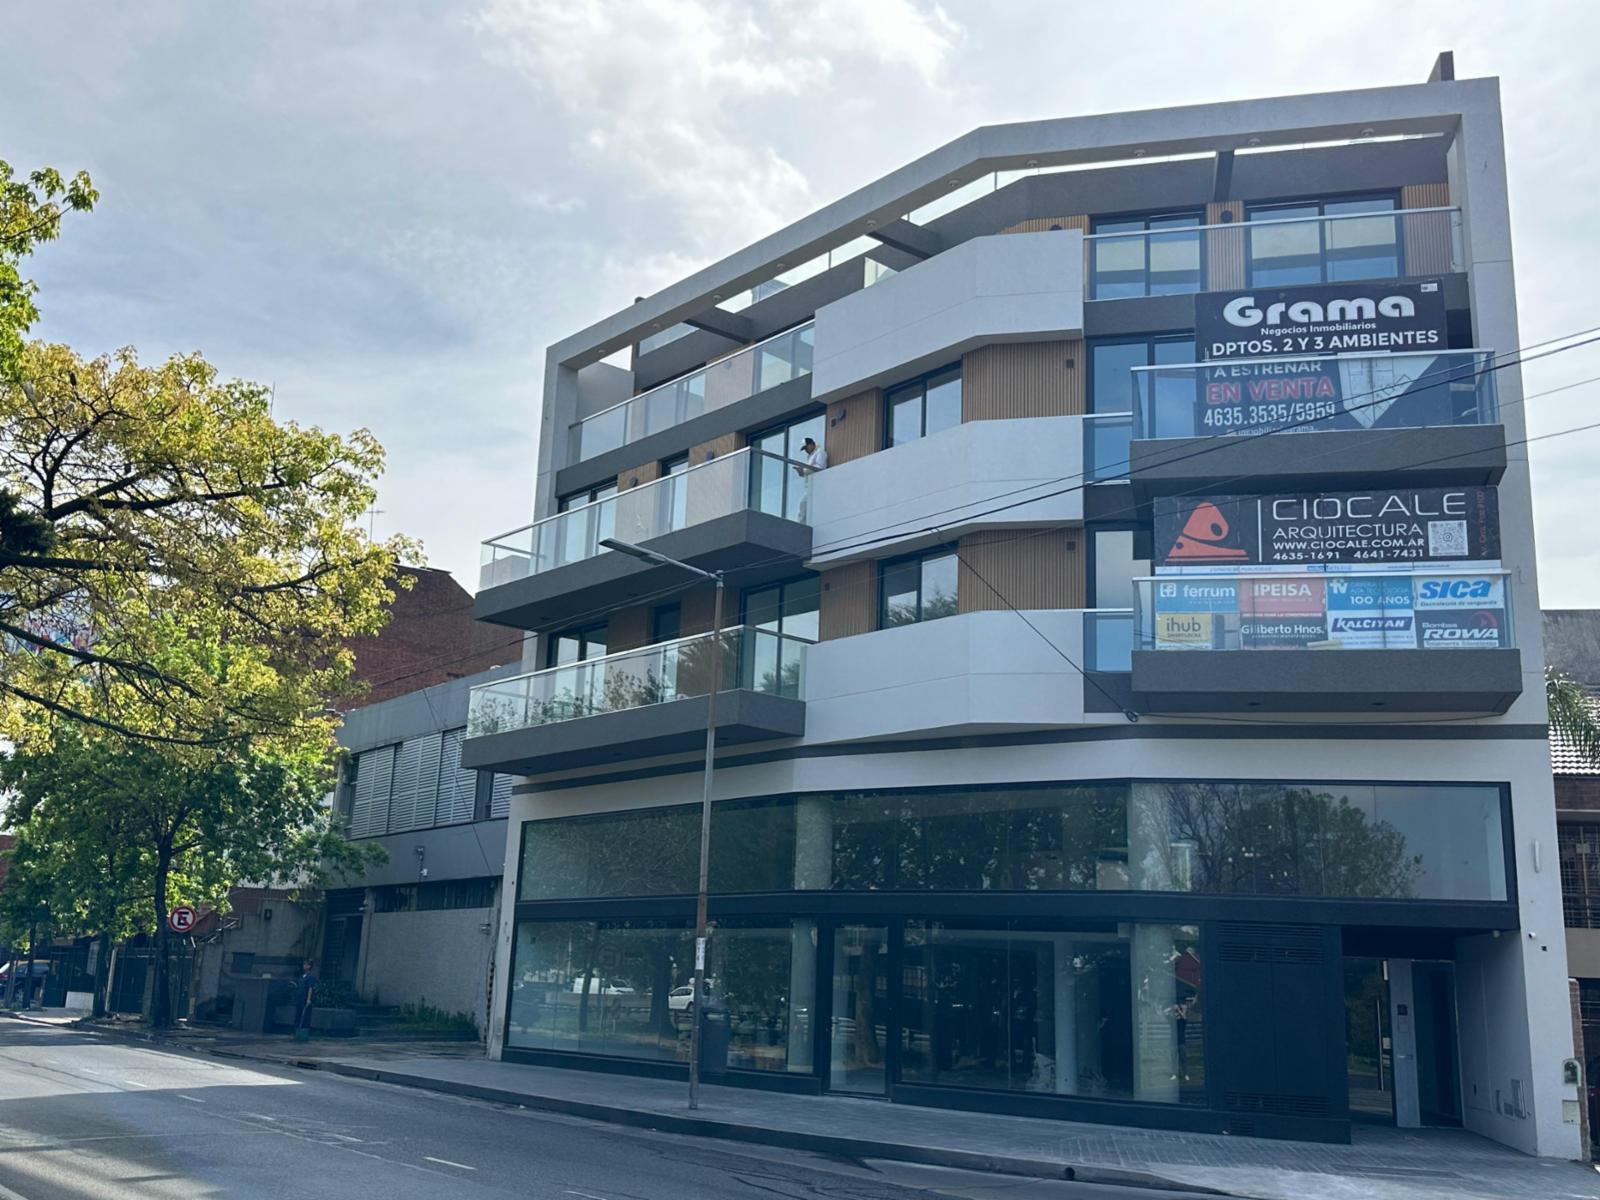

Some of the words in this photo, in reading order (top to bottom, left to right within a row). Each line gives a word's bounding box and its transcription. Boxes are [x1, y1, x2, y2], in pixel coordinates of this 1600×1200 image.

[1223, 295, 1415, 327] Grama
[1261, 326, 1308, 337] Negocios
[1310, 321, 1377, 334] Inmobiliarios
[1212, 339, 1278, 356] DPTOS.
[1283, 338, 1294, 352] 2
[1297, 337, 1309, 350] Y
[1314, 336, 1324, 349] 3
[1329, 330, 1439, 349] AMBIENTES
[1231, 361, 1322, 377] ESTRENAR
[1206, 382, 1241, 404] EN
[1247, 376, 1336, 401] VENTA
[1272, 492, 1467, 520] CIOCALE
[1273, 523, 1424, 539] ARQUITECTURA
[1273, 538, 1425, 550] WWW.CIOCALE.COM.AR
[1273, 551, 1340, 560] 4635-1691
[1353, 549, 1423, 559] 4641-7431
[1183, 584, 1236, 597] ferrum
[1254, 583, 1312, 597] IPEISA
[1350, 596, 1374, 605] 100
[1166, 617, 1202, 632] ihub
[1294, 624, 1325, 634] Hnos.
[1423, 628, 1499, 639] ROWA
